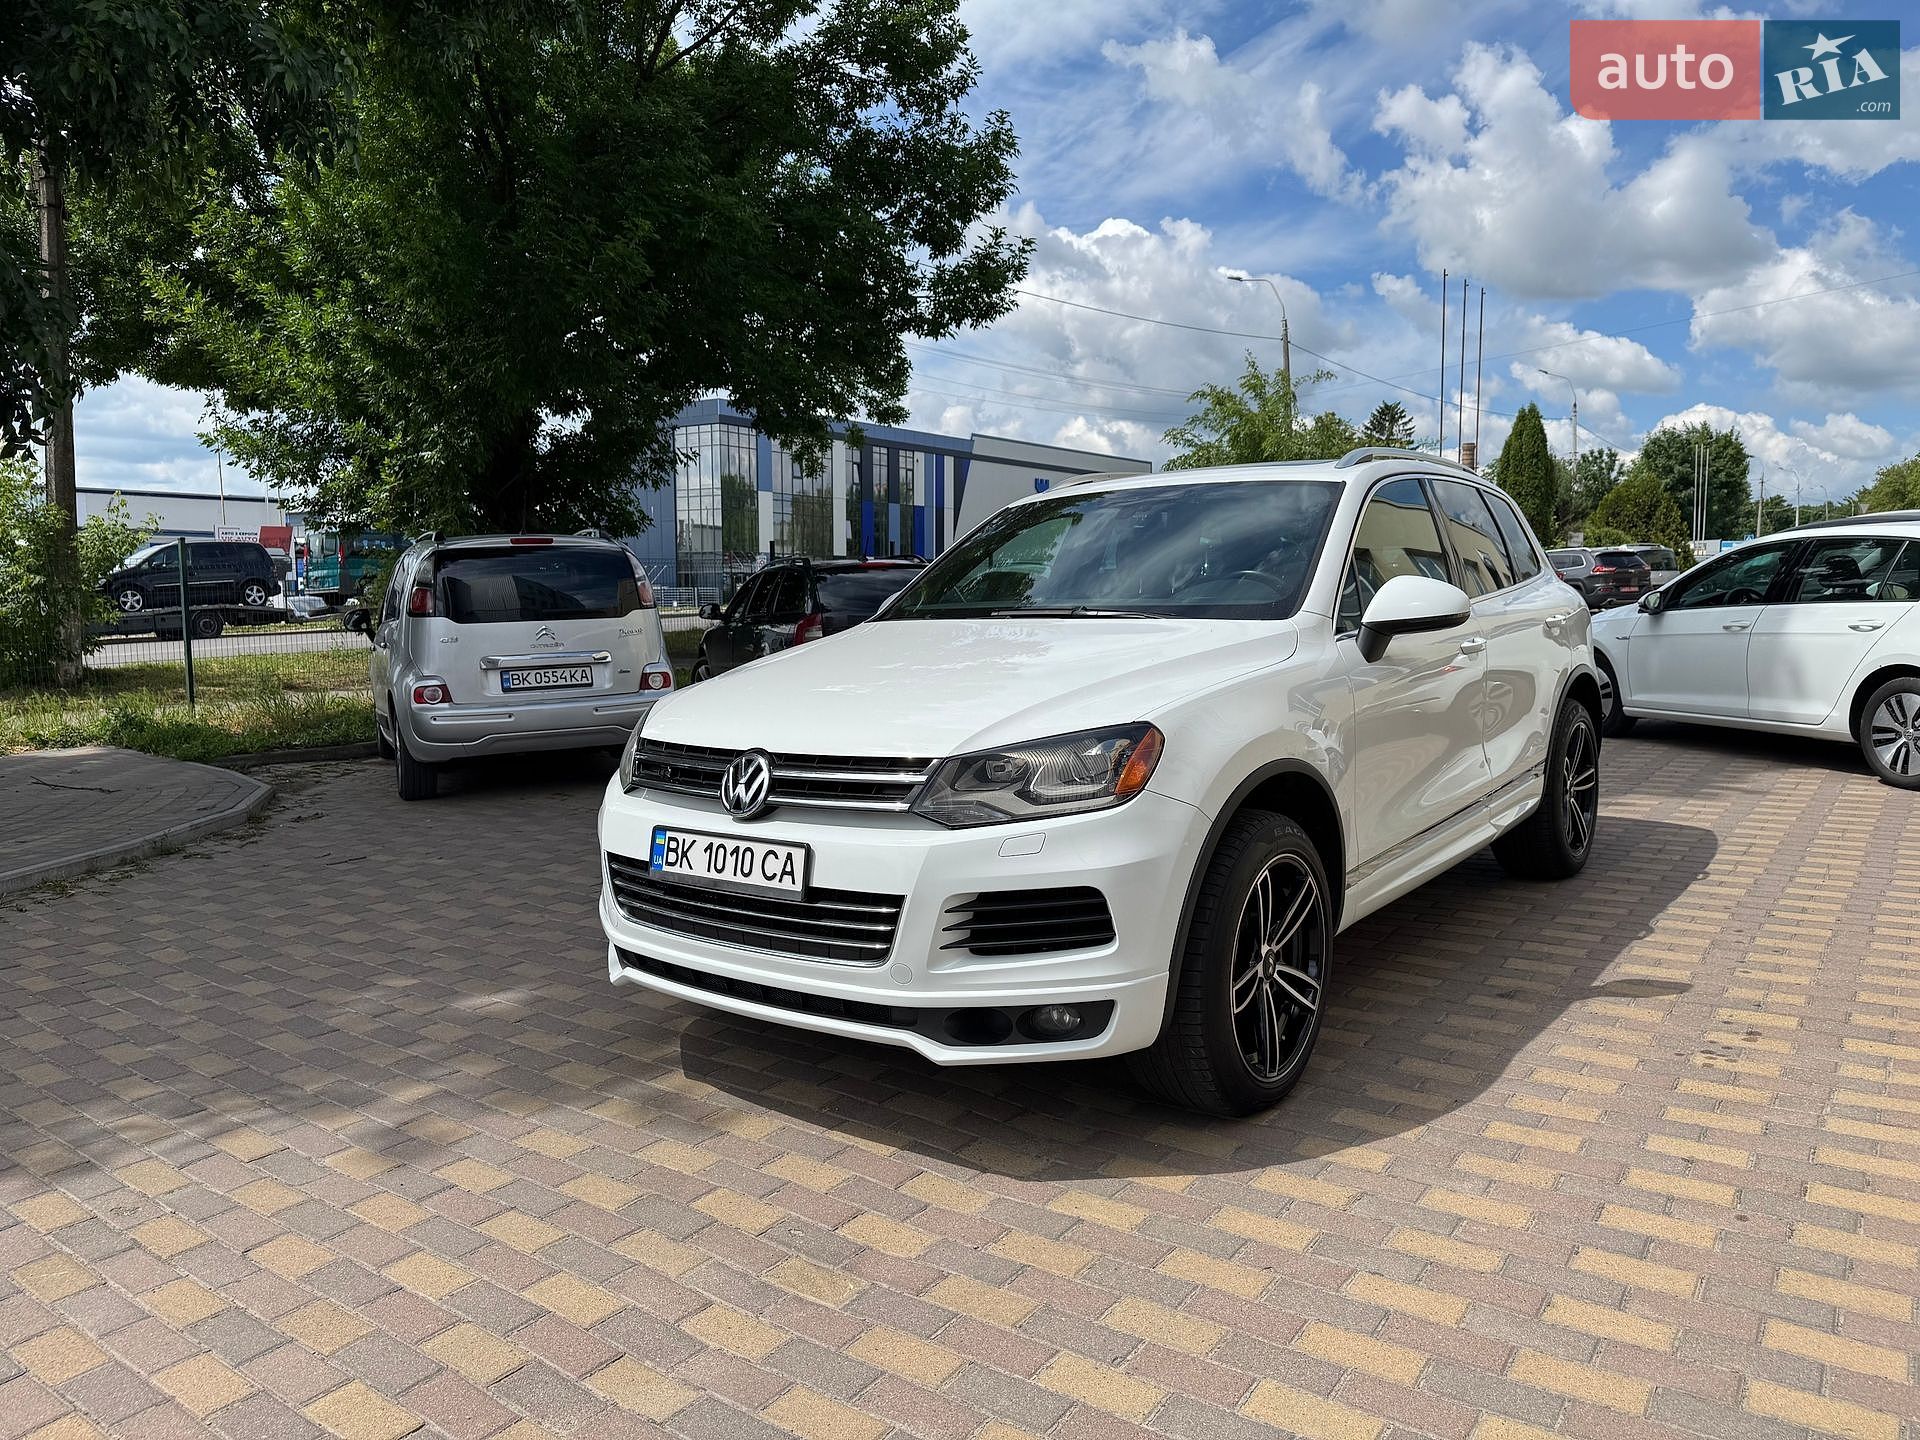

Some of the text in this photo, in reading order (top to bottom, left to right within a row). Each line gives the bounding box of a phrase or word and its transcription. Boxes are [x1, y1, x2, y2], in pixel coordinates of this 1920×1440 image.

[510, 669, 590, 686] BK 0554 KA
[653, 855, 663, 865] UA
[664, 836, 796, 885] BK 1010 CA
